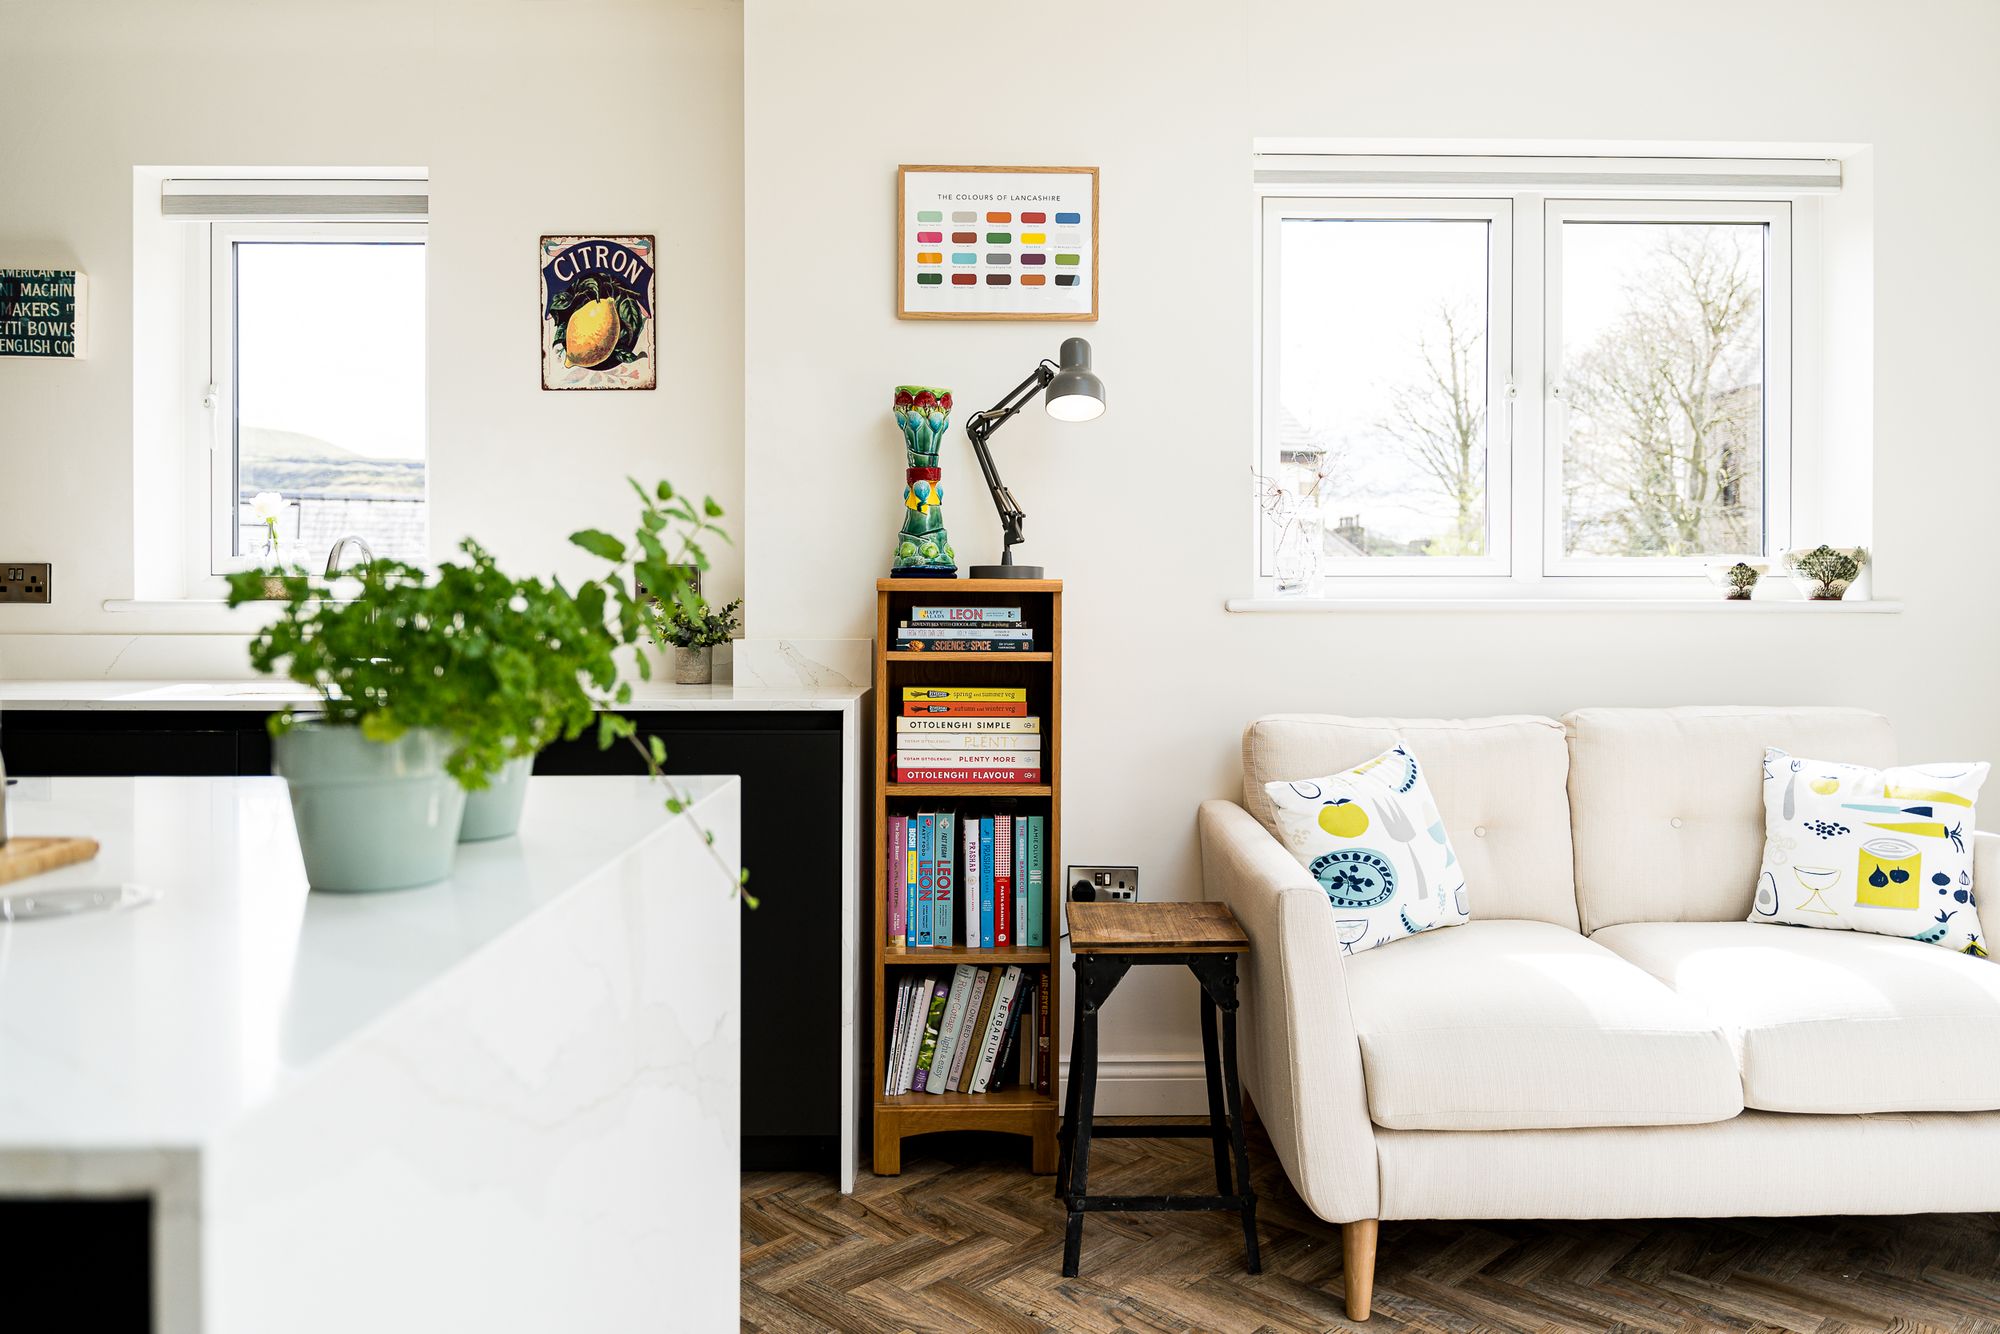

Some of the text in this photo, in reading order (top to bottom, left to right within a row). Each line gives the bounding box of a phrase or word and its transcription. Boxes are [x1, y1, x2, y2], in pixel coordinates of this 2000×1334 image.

[554, 246, 644, 284] CITRON
[1, 302, 60, 316] MAKERS
[28, 321, 75, 336] BOWLS
[0, 339, 50, 353] ENGLISH
[950, 609, 982, 620] LEON
[936, 641, 965, 650] SCIENCE
[971, 641, 991, 650] SPICE
[964, 737, 1018, 747] PLENTY
[919, 860, 932, 900] LEON
[936, 860, 950, 900] LEON
[1029, 870, 1041, 883] ONE
[973, 985, 982, 1000] VEG
[943, 979, 966, 1034] River Cottage
[966, 1008, 976, 1024] ONE
[963, 1024, 972, 1038] BED
[983, 996, 1009, 1063] HERBARIUM
[938, 1035, 953, 1054] light
[932, 1059, 945, 1078] easy
